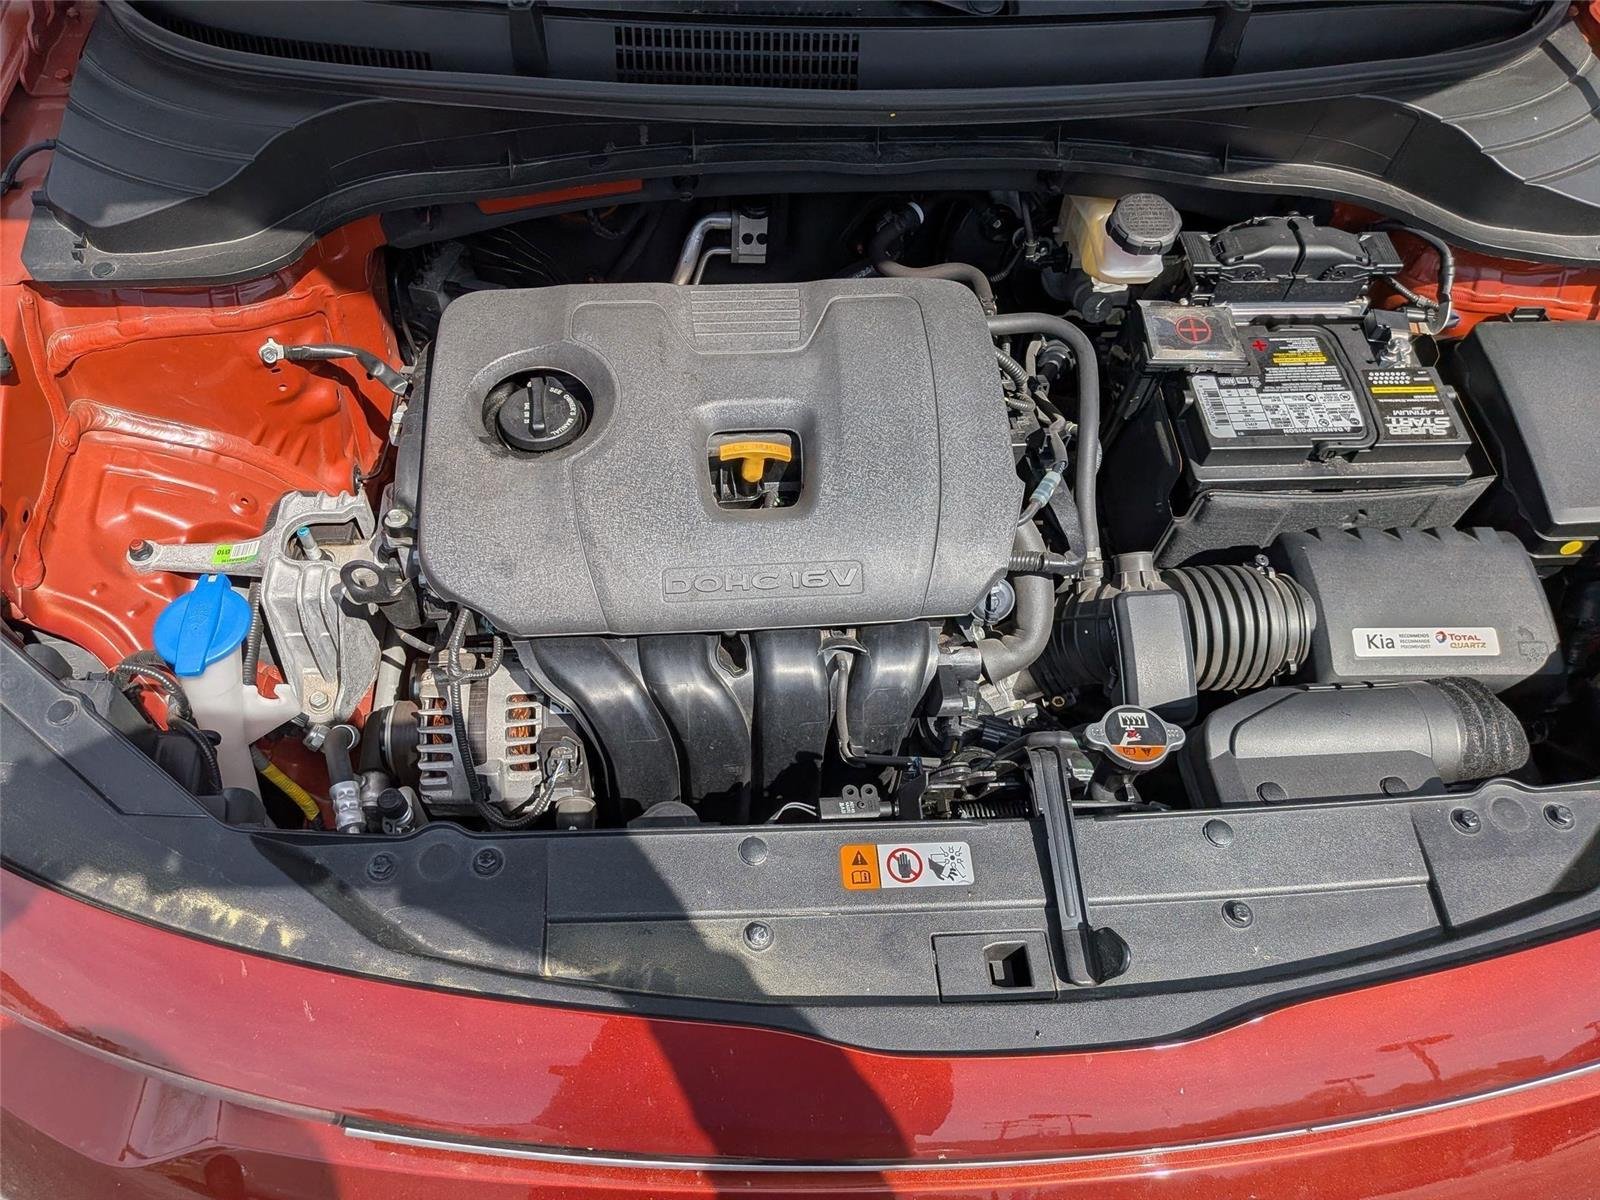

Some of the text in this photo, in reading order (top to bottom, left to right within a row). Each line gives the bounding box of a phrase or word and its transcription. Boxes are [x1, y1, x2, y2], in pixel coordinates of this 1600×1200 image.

[549, 387, 563, 396] SEE
[550, 418, 574, 436] MANUAL
[1385, 416, 1450, 428] START
[1388, 426, 1447, 436] SUPER
[665, 567, 859, 595] DOHC 16V
[1366, 634, 1395, 650] Kia
[1447, 633, 1482, 642] TOTAL
[1450, 642, 1487, 650] QUARTZ
